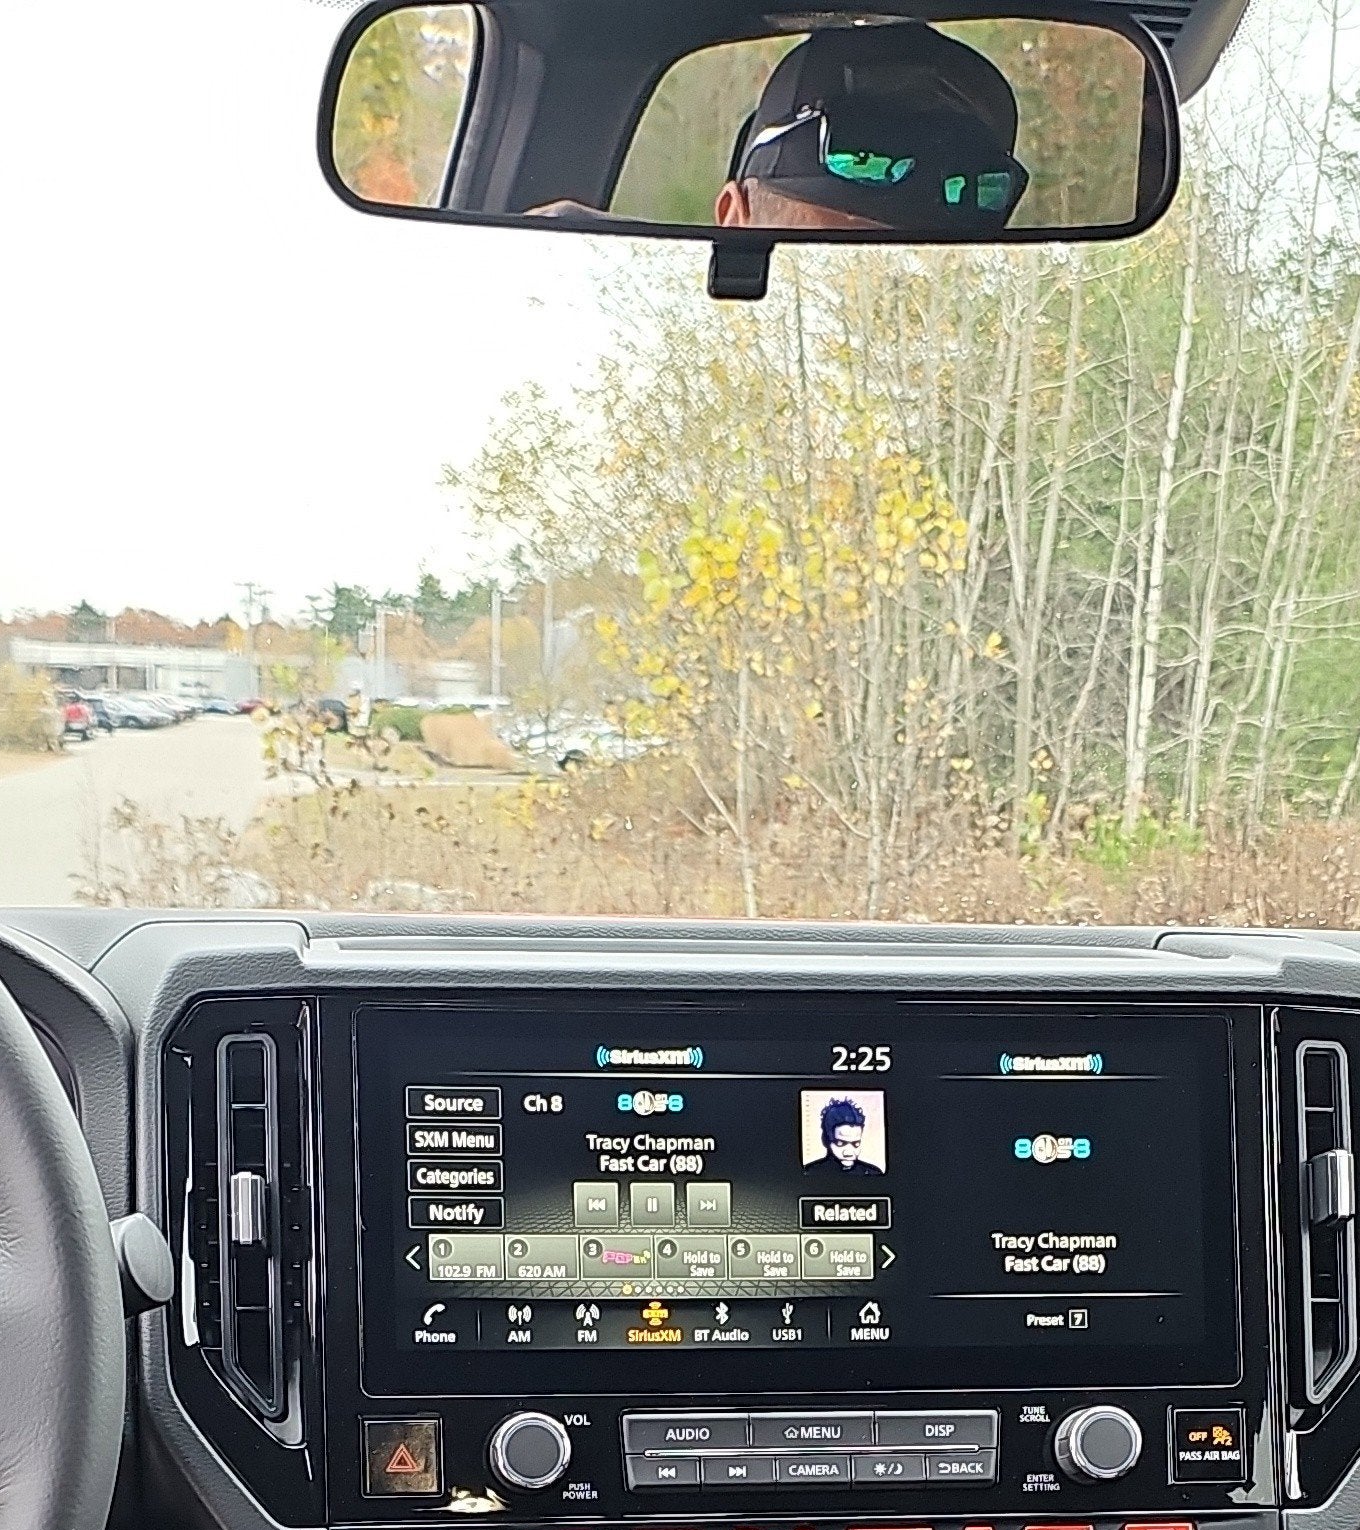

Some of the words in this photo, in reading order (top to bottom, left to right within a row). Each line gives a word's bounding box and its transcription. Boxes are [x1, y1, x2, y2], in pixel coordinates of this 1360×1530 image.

[832, 1047, 891, 1071] 2:25
[424, 1094, 484, 1112] Source
[523, 1094, 547, 1112] Ch
[550, 1095, 563, 1112] 8
[414, 1131, 448, 1148] SXM
[452, 1131, 494, 1148] Menu
[586, 1134, 630, 1153] Tracy
[634, 1134, 714, 1153] Chapman
[600, 1155, 635, 1172] Fast
[637, 1156, 667, 1172] Car
[670, 1154, 703, 1174] (88)
[416, 1168, 494, 1188] Categories
[429, 1204, 484, 1224] Notify
[813, 1205, 876, 1222] Related
[991, 1232, 1036, 1253] Tracy
[1037, 1232, 1117, 1252] Chapman
[684, 1251, 708, 1264] Hold
[709, 1252, 720, 1264] to
[757, 1251, 781, 1264] Hold
[783, 1252, 794, 1264] to
[830, 1251, 854, 1263] Hold
[856, 1251, 866, 1263] to
[1004, 1255, 1040, 1272] Fast
[1041, 1255, 1070, 1272] Car
[1072, 1254, 1106, 1274] (88)
[438, 1266, 471, 1278] 102.9
[476, 1266, 495, 1278] FM
[519, 1266, 541, 1278] 620
[543, 1266, 566, 1278] AM
[690, 1265, 715, 1277] Save
[763, 1265, 788, 1277] Save
[836, 1265, 861, 1277] Save
[1026, 1313, 1065, 1327] Preset
[415, 1331, 456, 1343] Phone
[507, 1330, 531, 1343] AM
[577, 1330, 597, 1343] FM
[628, 1329, 681, 1342] SiriusXM
[694, 1329, 710, 1341] BT
[712, 1329, 749, 1341] Audio
[772, 1329, 802, 1341] USB1
[851, 1328, 890, 1340] MENU
[1022, 1406, 1046, 1415] TUNE
[564, 1415, 591, 1426] VOL
[1019, 1413, 1051, 1424] SCROLL
[666, 1427, 710, 1441] AUDIO
[800, 1426, 841, 1439] MENU
[925, 1424, 955, 1438] DISP
[1189, 1431, 1208, 1442] OFF
[1179, 1451, 1202, 1461] PASS
[1203, 1451, 1219, 1461] AIR
[1221, 1450, 1240, 1461] BAG
[788, 1464, 839, 1476] CAMERA
[951, 1461, 984, 1474] BACK
[1026, 1474, 1055, 1483] ENTER
[568, 1483, 591, 1491] PUSH
[1022, 1482, 1061, 1492] SETTING
[562, 1490, 598, 1500] POWER
